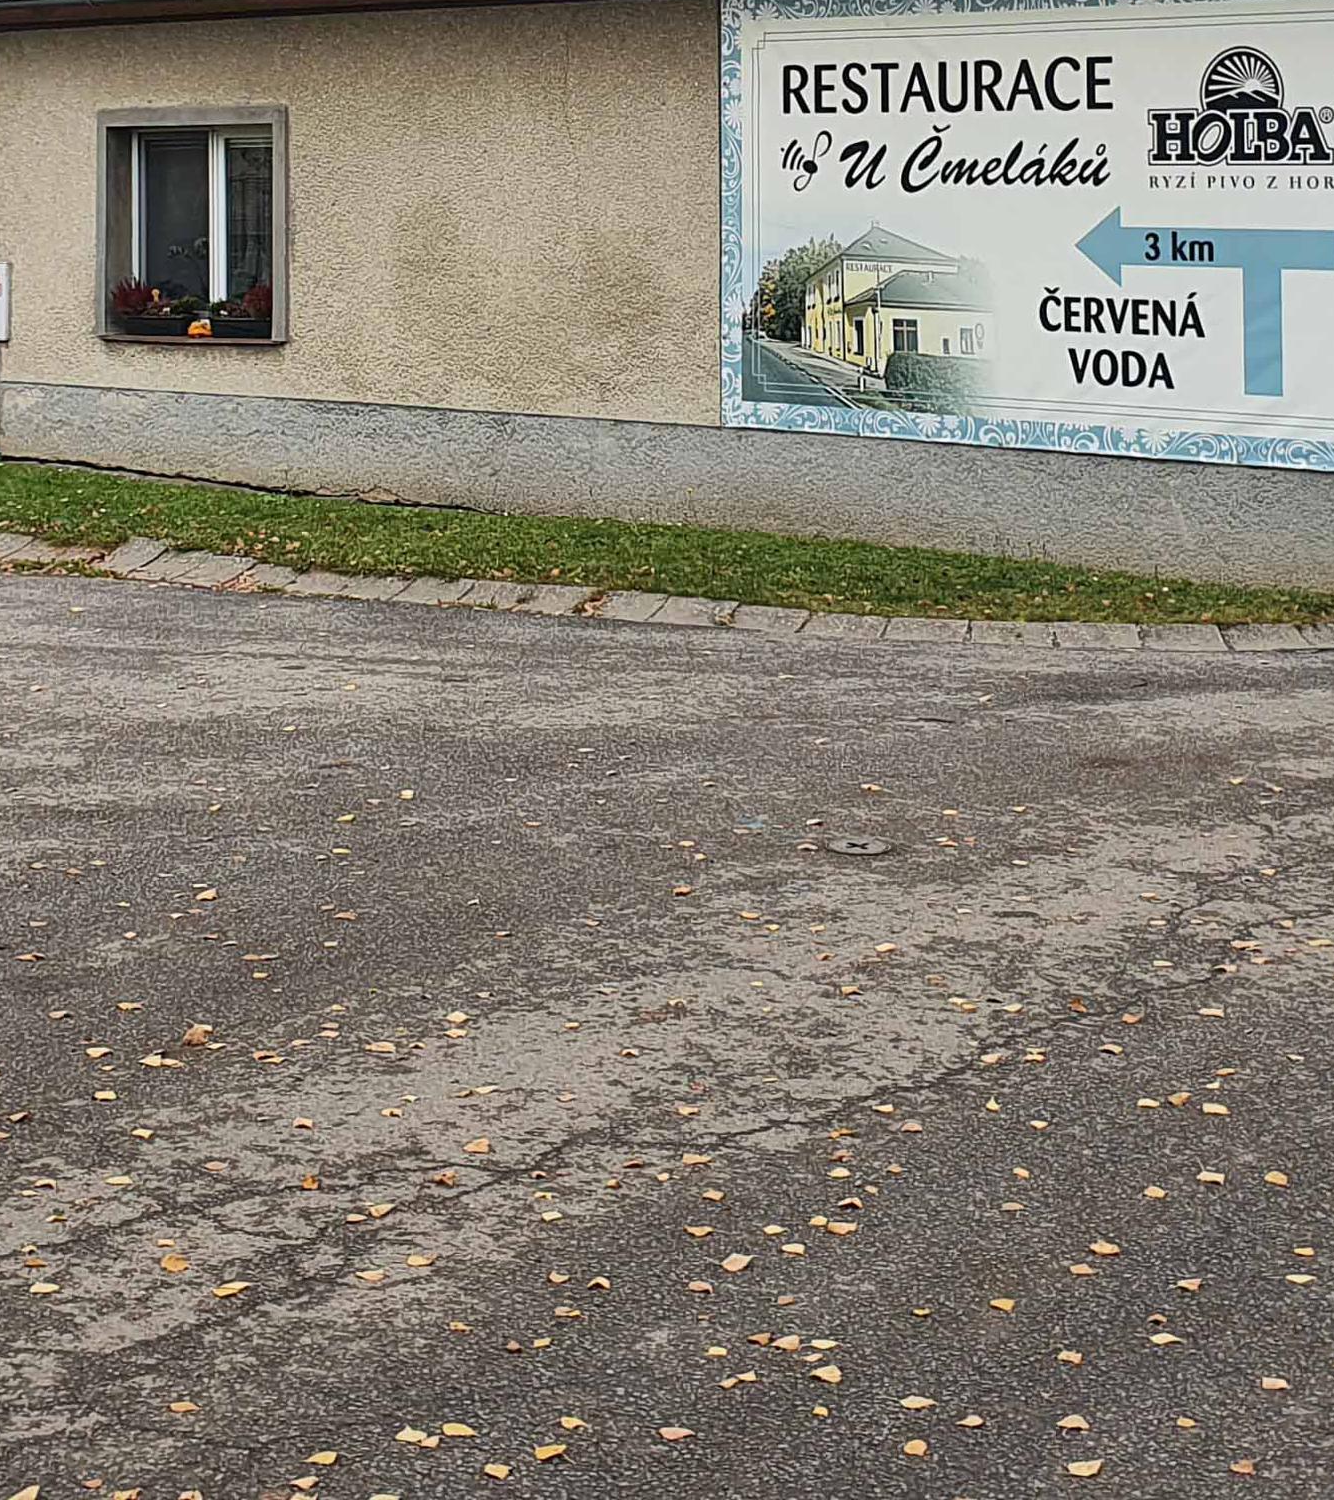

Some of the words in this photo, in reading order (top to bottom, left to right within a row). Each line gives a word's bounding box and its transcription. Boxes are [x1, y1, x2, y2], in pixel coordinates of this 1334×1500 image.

[782, 56, 1113, 114] RESTAURACE
[839, 140, 887, 189] U
[900, 124, 1111, 193] Čmeláků
[1148, 172, 1196, 189] RYZÍ
[1207, 175, 1255, 190] PIVO
[1266, 175, 1278, 190] Z
[1144, 232, 1161, 261] 3
[1171, 231, 1214, 262] km
[1039, 286, 1205, 338] ČERVENÁ
[1068, 348, 1175, 389] VODA
